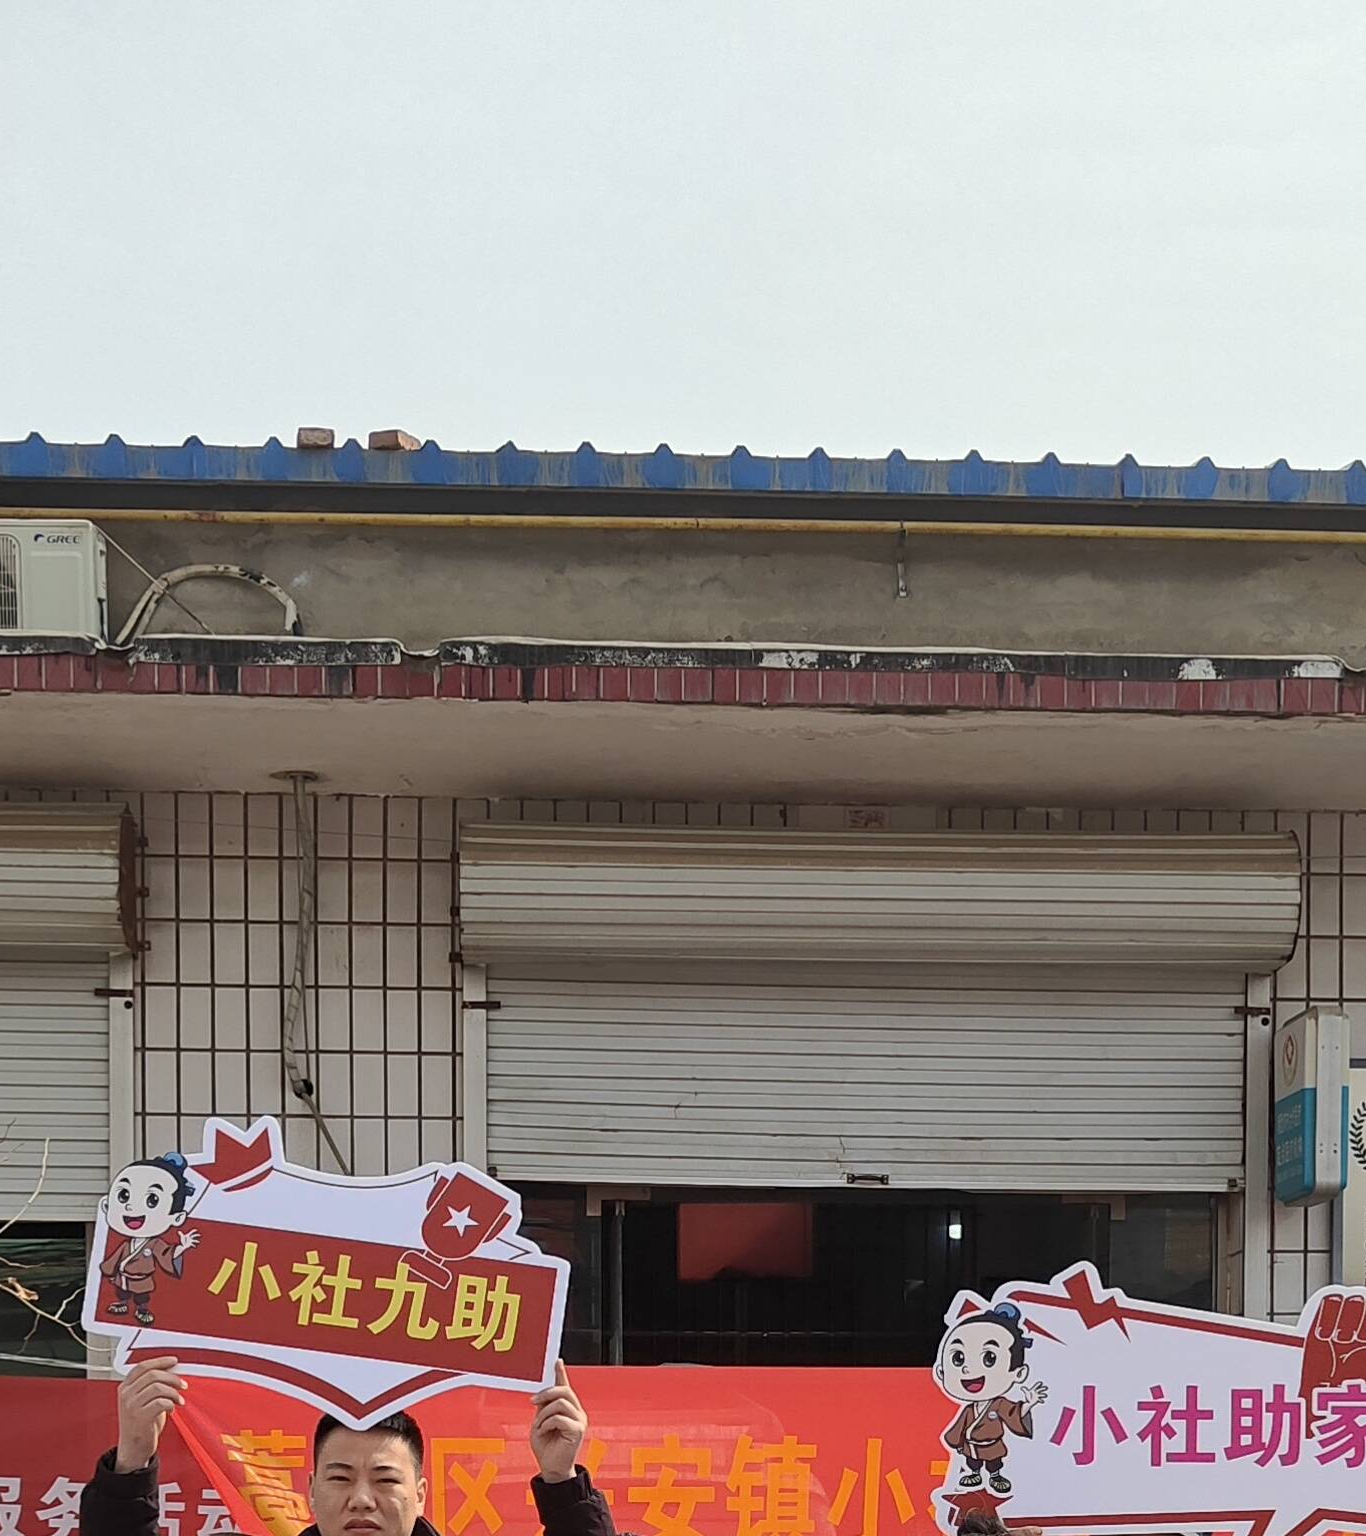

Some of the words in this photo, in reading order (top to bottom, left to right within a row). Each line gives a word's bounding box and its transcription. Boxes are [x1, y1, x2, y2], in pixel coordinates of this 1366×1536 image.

[46, 534, 81, 545] GREE
[208, 1241, 523, 1353] 小社九助
